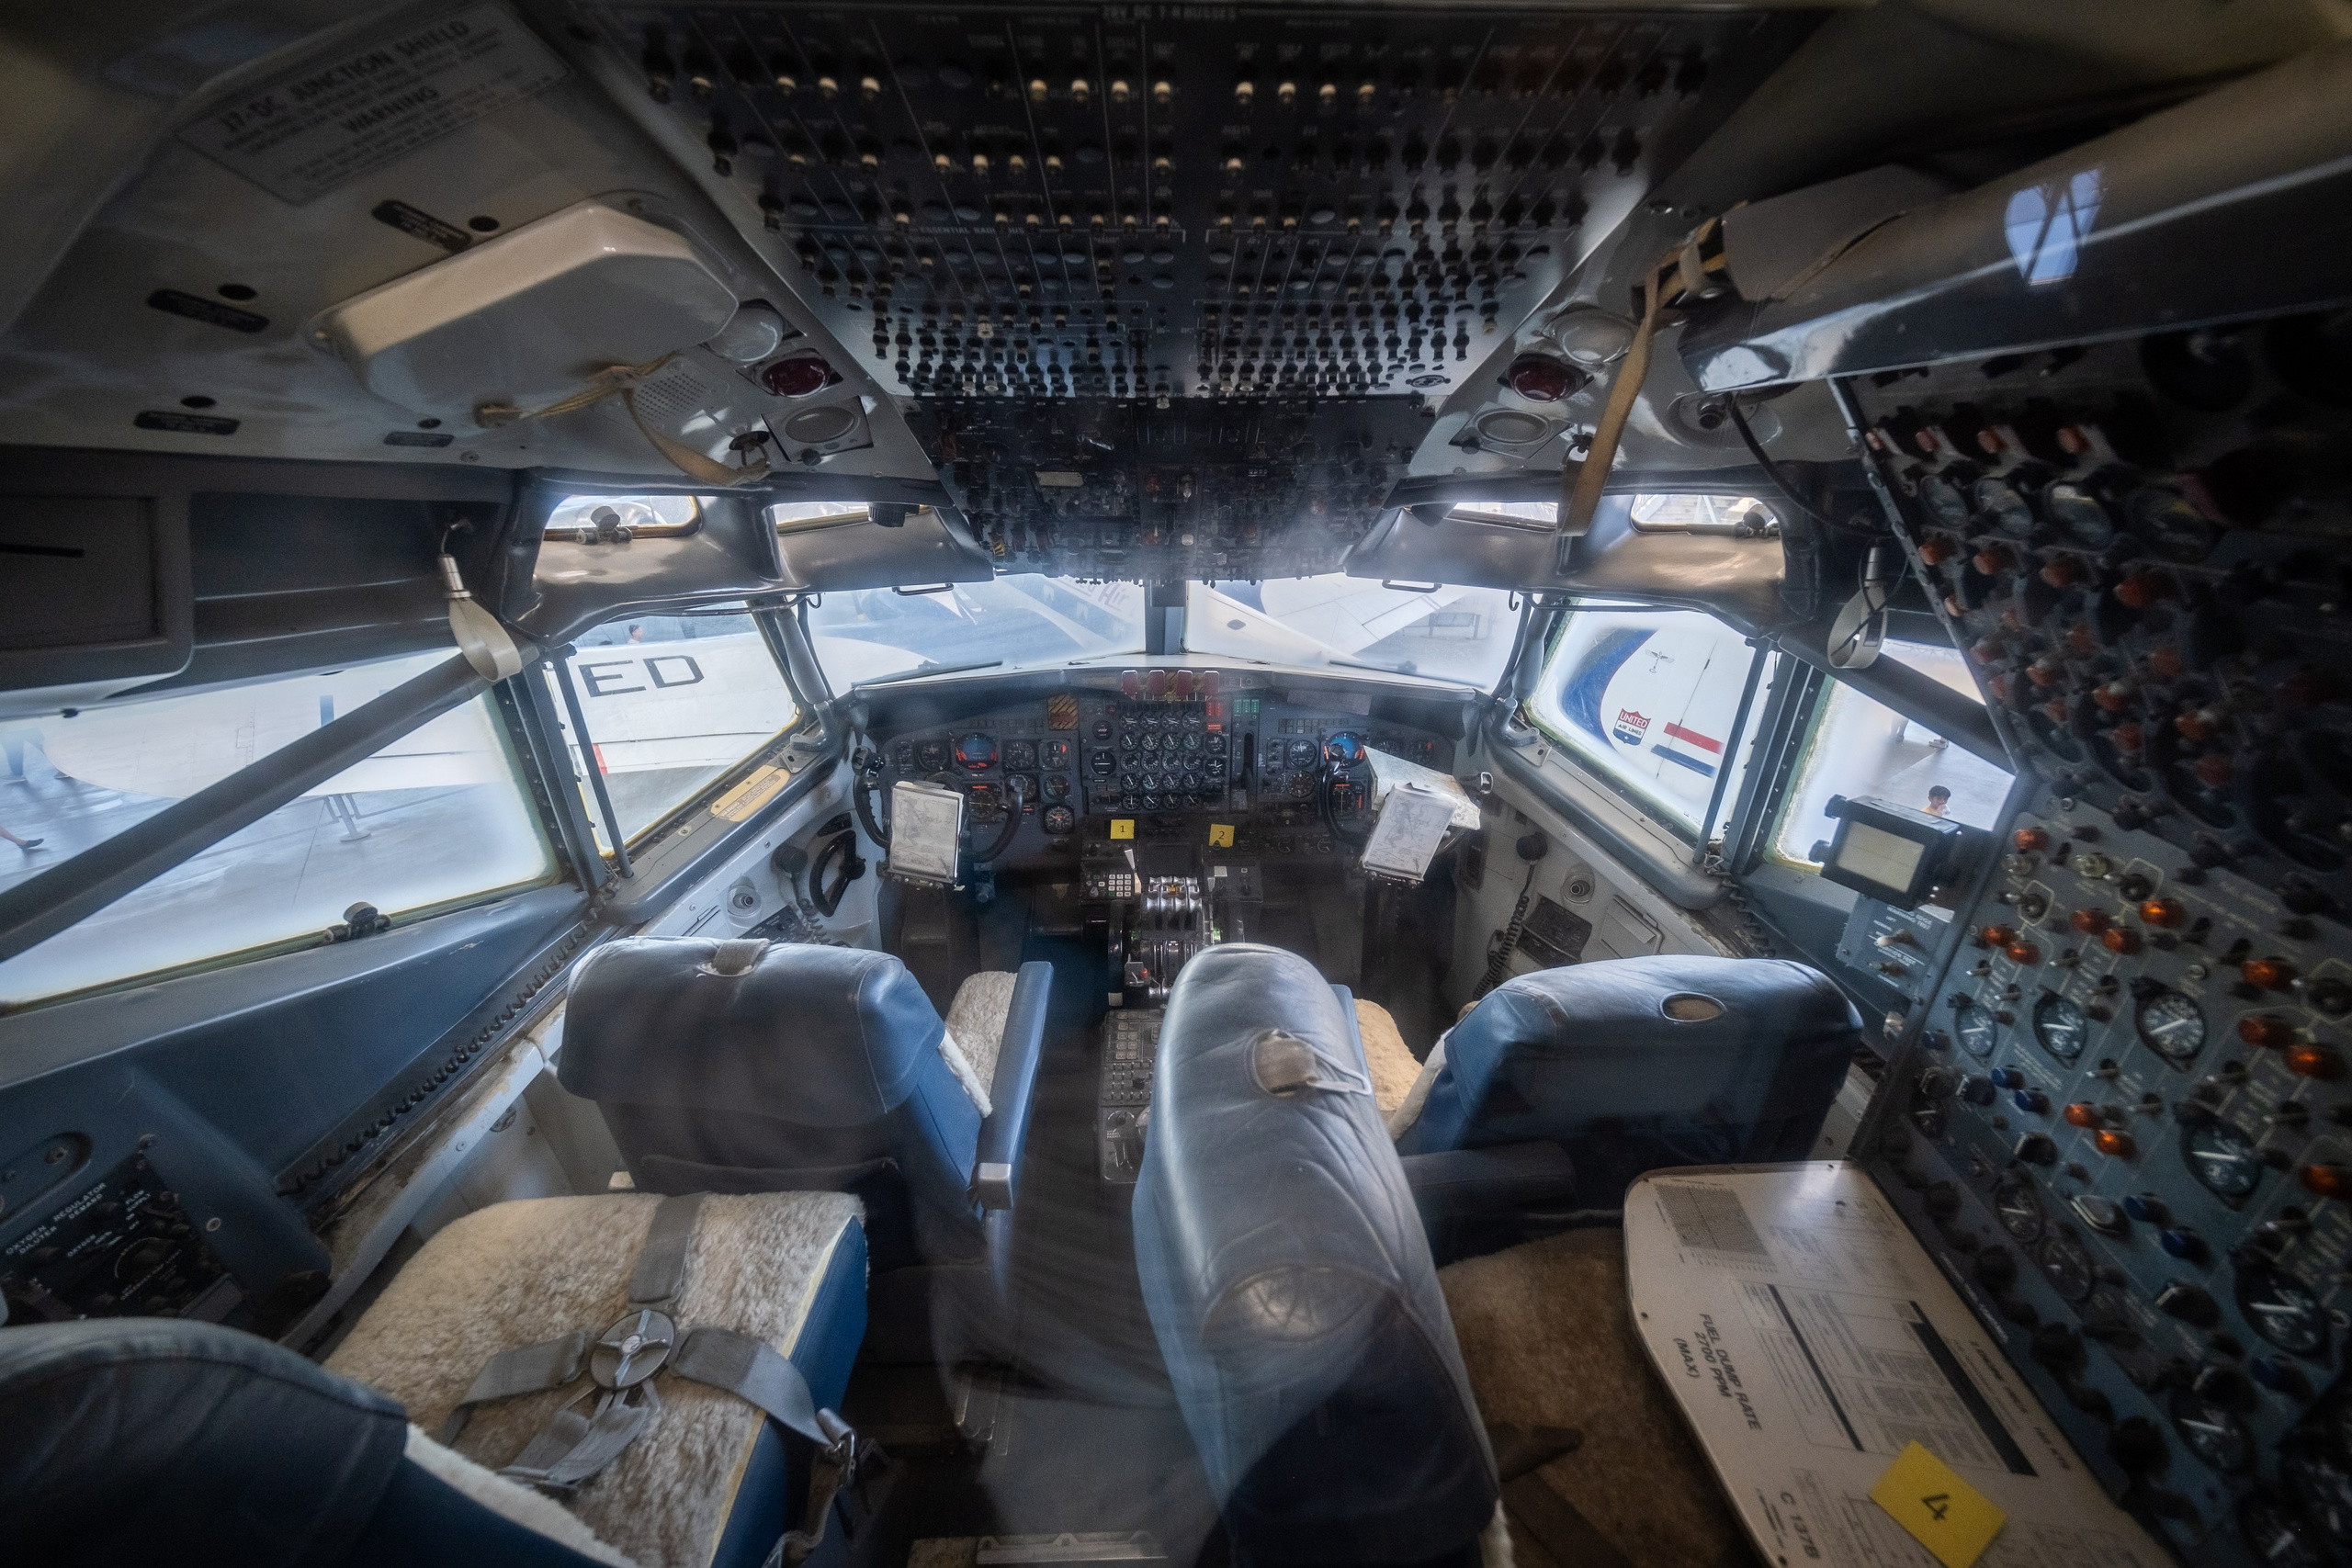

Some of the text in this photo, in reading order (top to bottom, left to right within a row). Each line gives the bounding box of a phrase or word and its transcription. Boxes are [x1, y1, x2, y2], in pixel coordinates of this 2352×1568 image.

[577, 654, 705, 698] ED
[1620, 712, 1647, 728] UNITED
[1218, 830, 1225, 840] 2
[5, 1181, 107, 1257] OXYGEN REGULATOR
[18, 1193, 104, 1255] DILUTER DEMAND
[1672, 1337, 1701, 1379] (MAX)
[1694, 1330, 1733, 1399] 2700 PPM
[1699, 1312, 1763, 1432] FUEL DUMP RATE
[1780, 1491, 1797, 1506] C
[1921, 1493, 1951, 1520] 4
